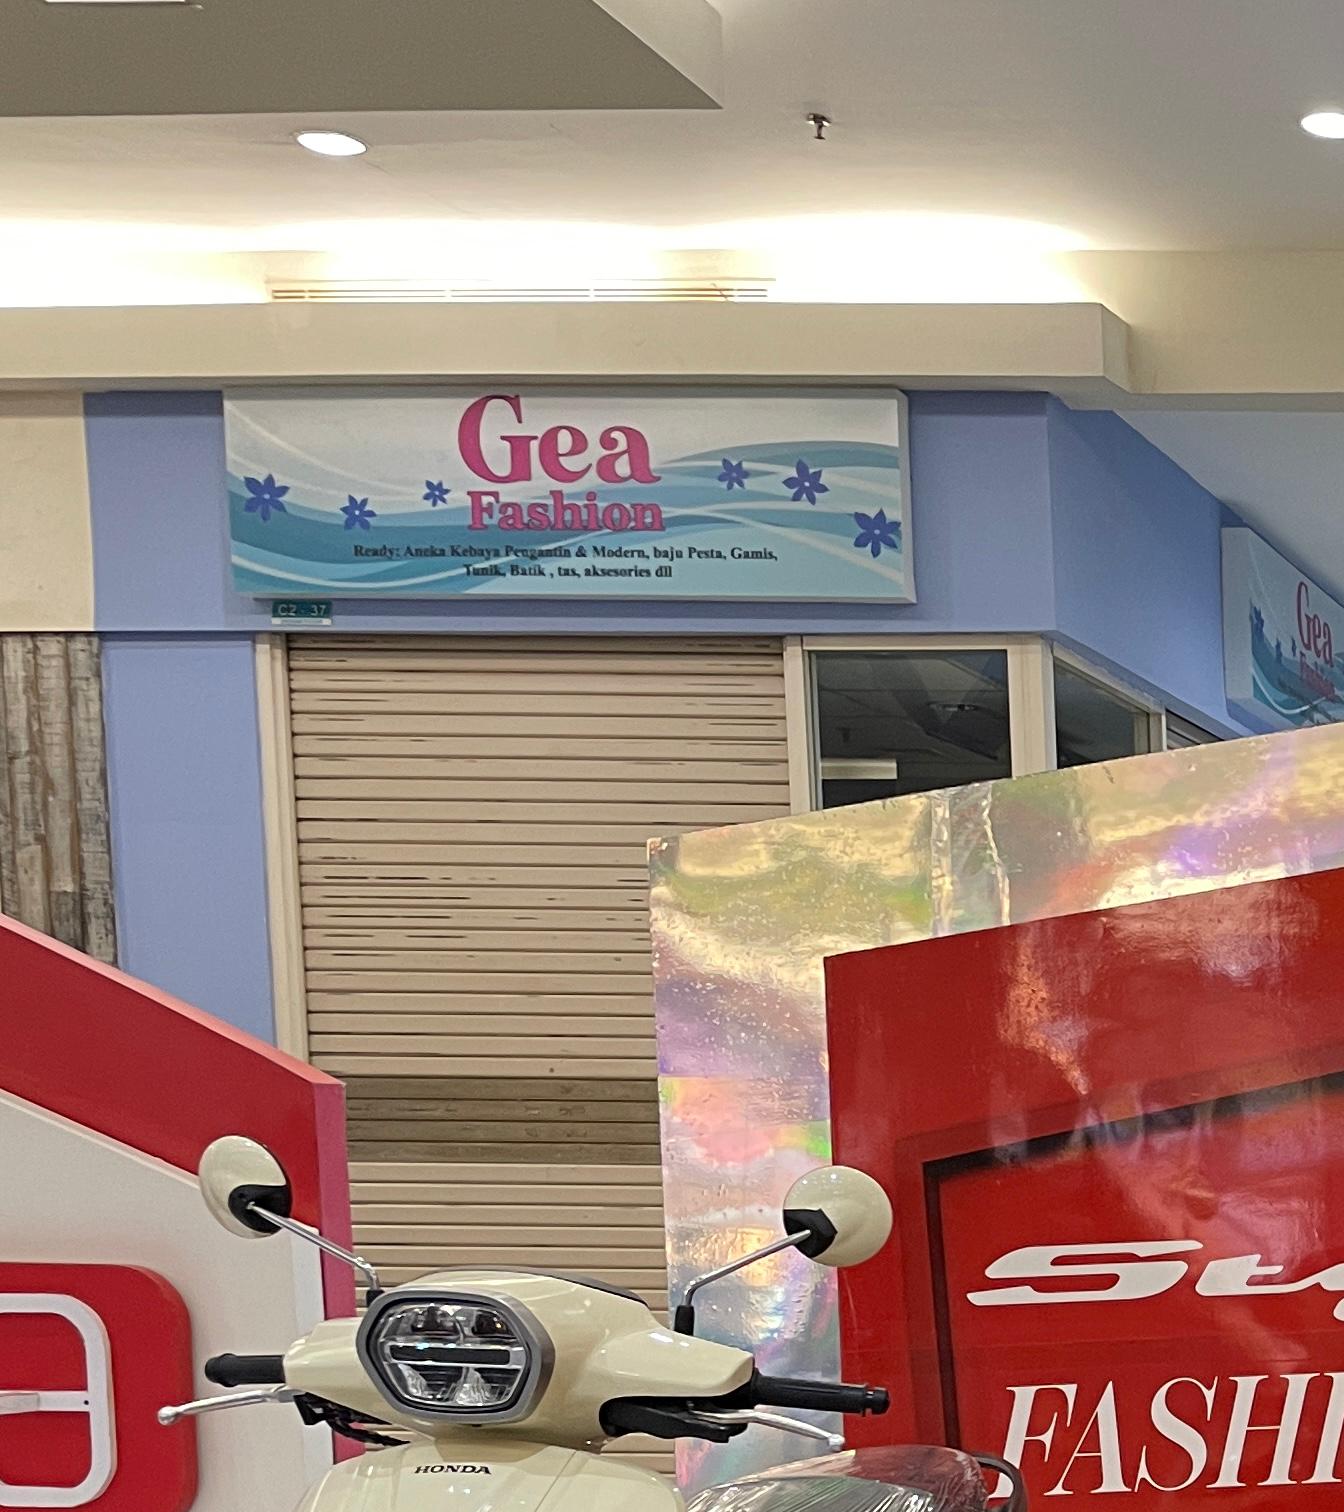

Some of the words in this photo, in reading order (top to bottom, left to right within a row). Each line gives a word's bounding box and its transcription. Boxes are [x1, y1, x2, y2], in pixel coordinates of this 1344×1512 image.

[458, 394, 661, 485] Gea
[467, 490, 665, 532] Fashion
[353, 544, 400, 559] Ready:
[403, 545, 446, 557] Aneka
[450, 545, 500, 560] Kebaya
[505, 545, 571, 560] Pengantin
[575, 546, 587, 558] &
[593, 546, 650, 560] Modern,
[653, 546, 684, 562] baju
[688, 547, 727, 560] Pesta,
[730, 547, 778, 561] Gamis,
[464, 564, 506, 577] Tunik,
[557, 565, 581, 578] tas,
[584, 565, 651, 578] aksesories
[655, 565, 673, 578] dll
[1297, 581, 1334, 667] Gea
[414, 1464, 492, 1475] HONDA
